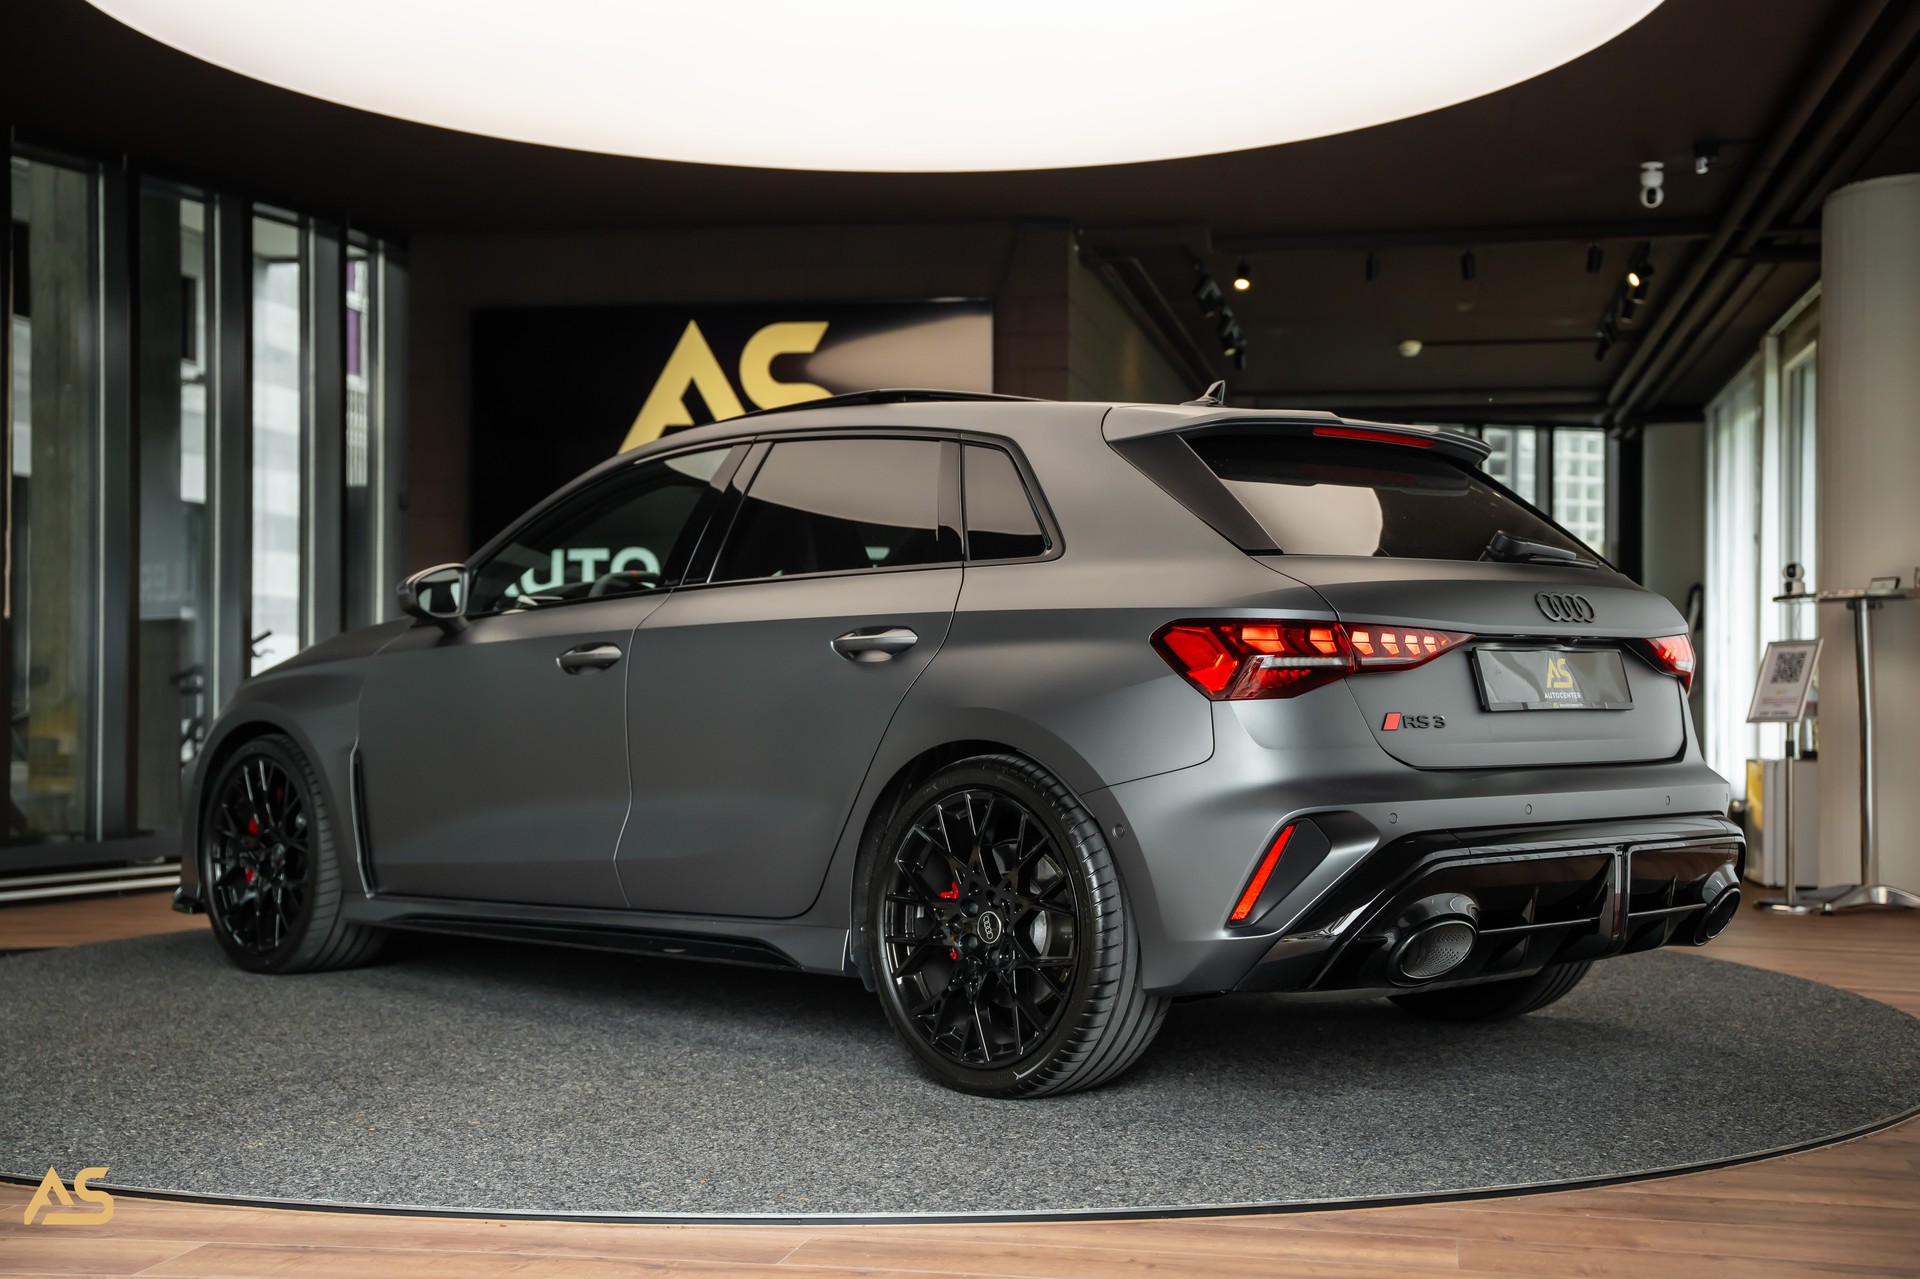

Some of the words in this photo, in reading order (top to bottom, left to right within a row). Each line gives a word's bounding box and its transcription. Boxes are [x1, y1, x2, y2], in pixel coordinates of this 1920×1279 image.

[1547, 658, 1573, 688] AS
[1403, 715, 1429, 729] RS
[1433, 715, 1446, 728] 3
